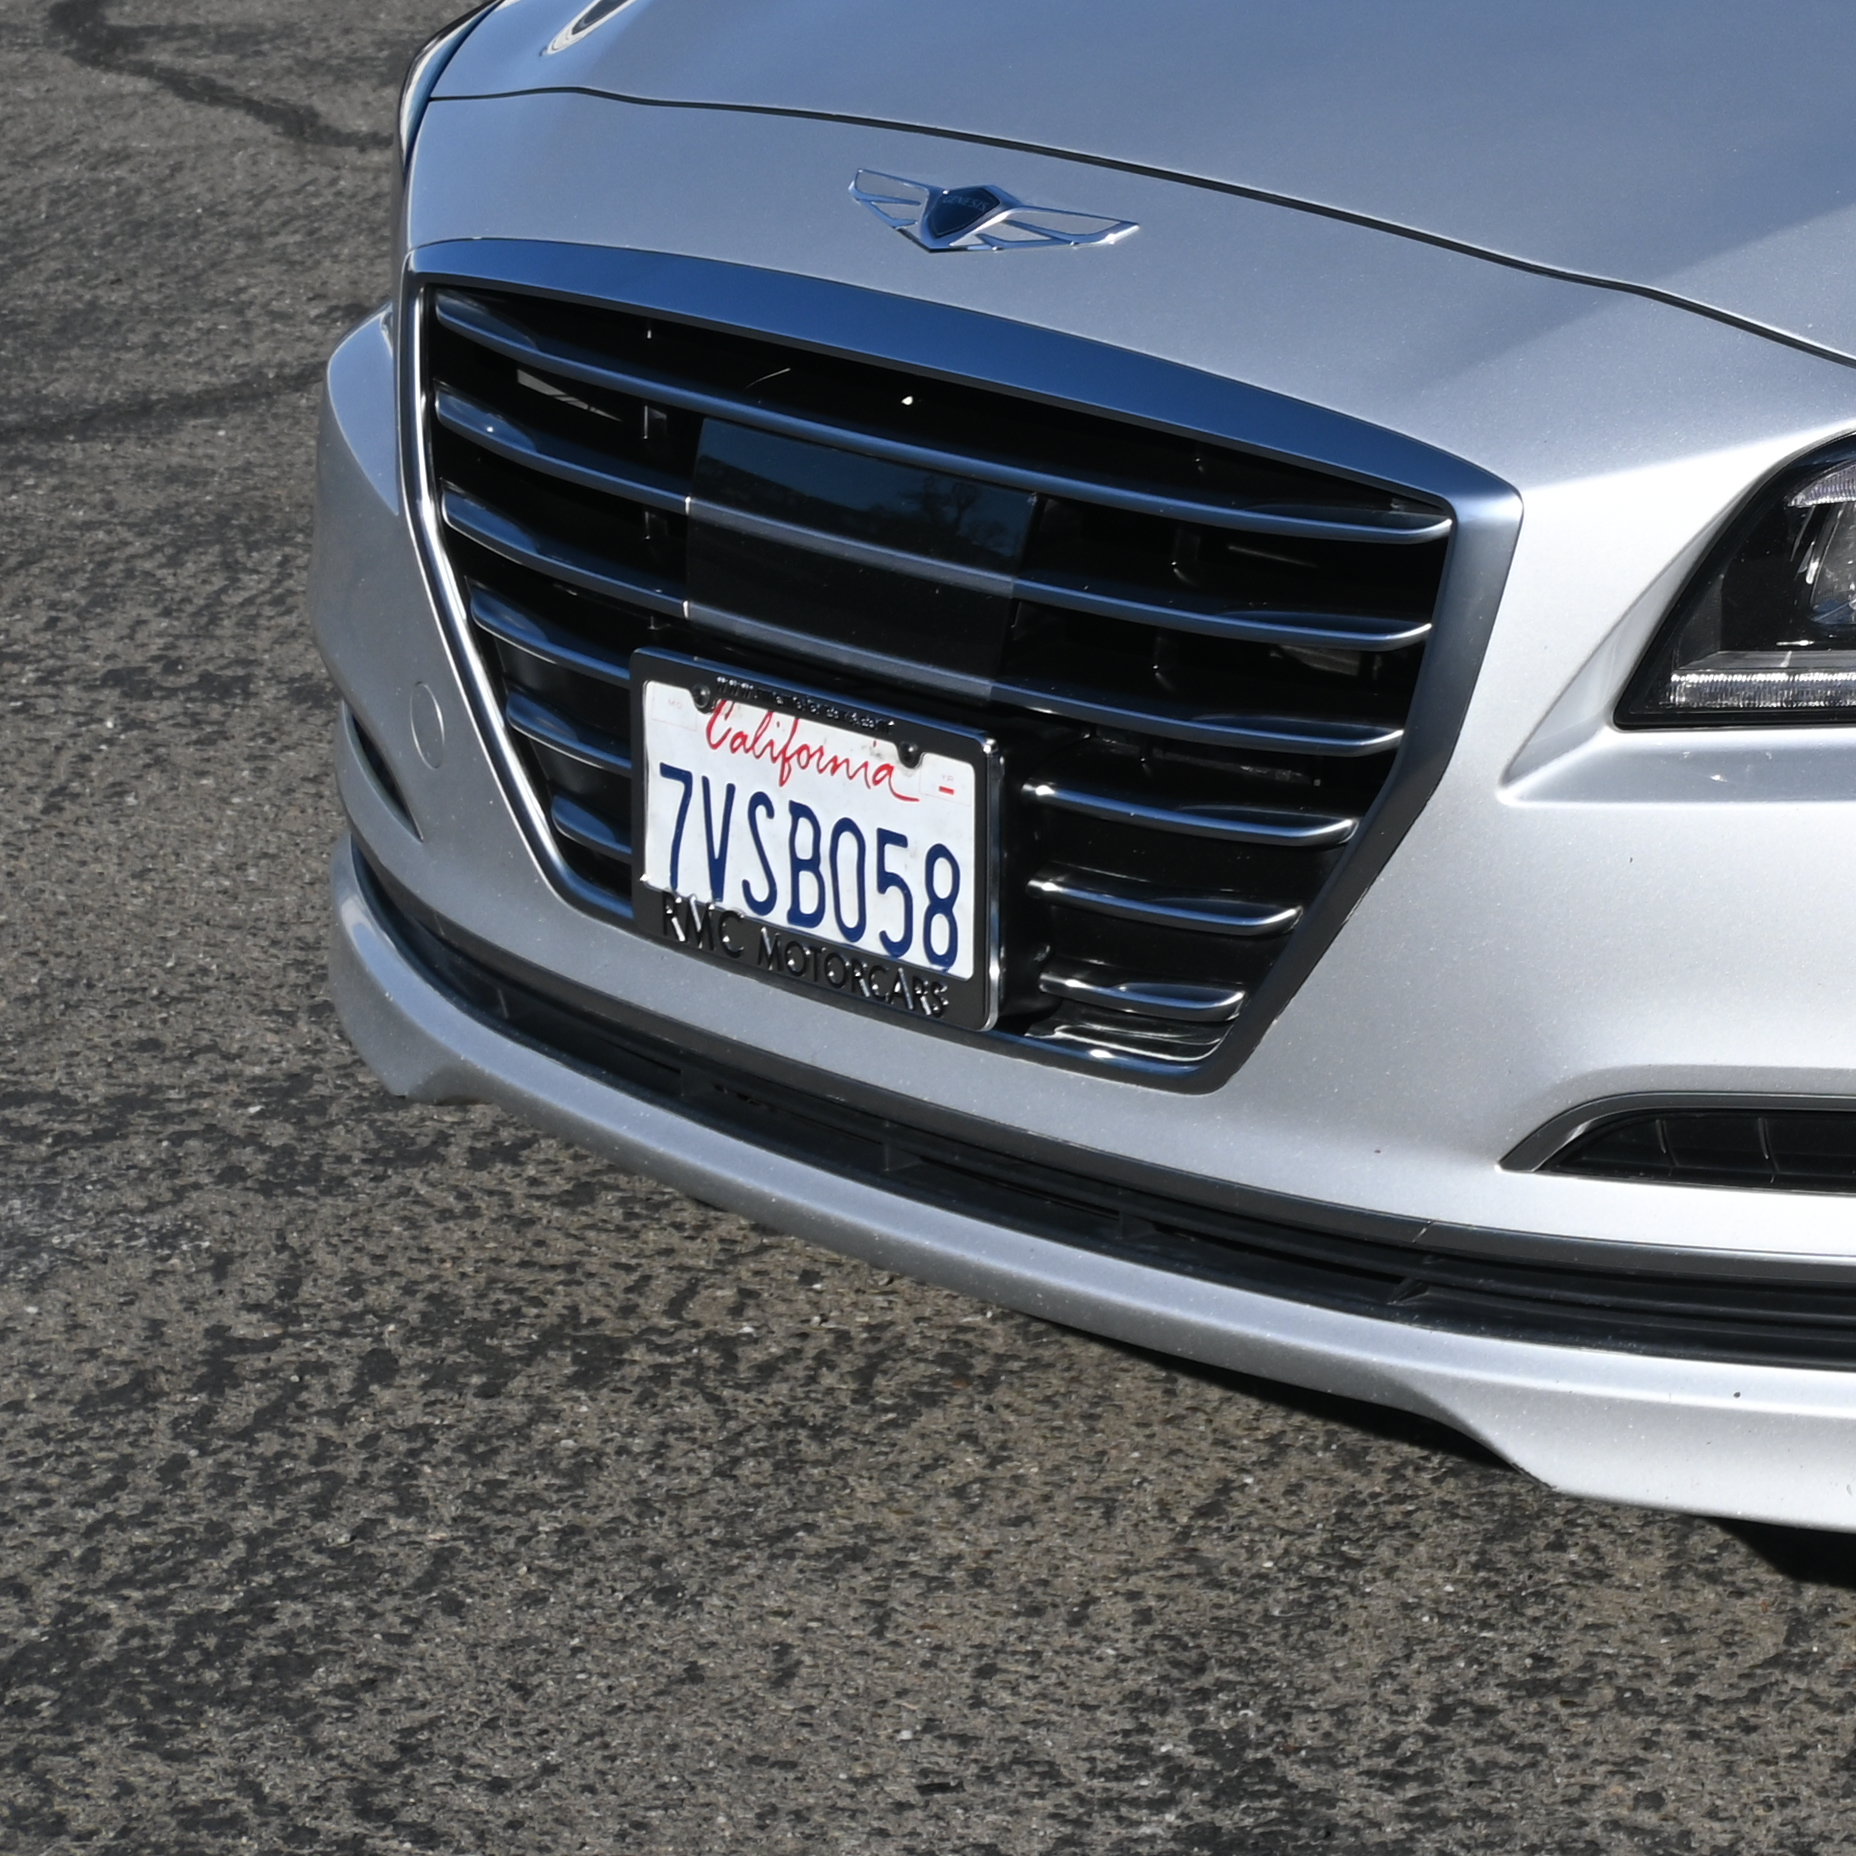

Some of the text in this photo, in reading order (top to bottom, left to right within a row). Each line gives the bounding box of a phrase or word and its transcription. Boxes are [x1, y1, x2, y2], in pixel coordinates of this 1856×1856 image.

[706, 698, 919, 803] California
[660, 762, 960, 973] 7VSB058
[661, 891, 949, 1017] RMC MOTORCARS
